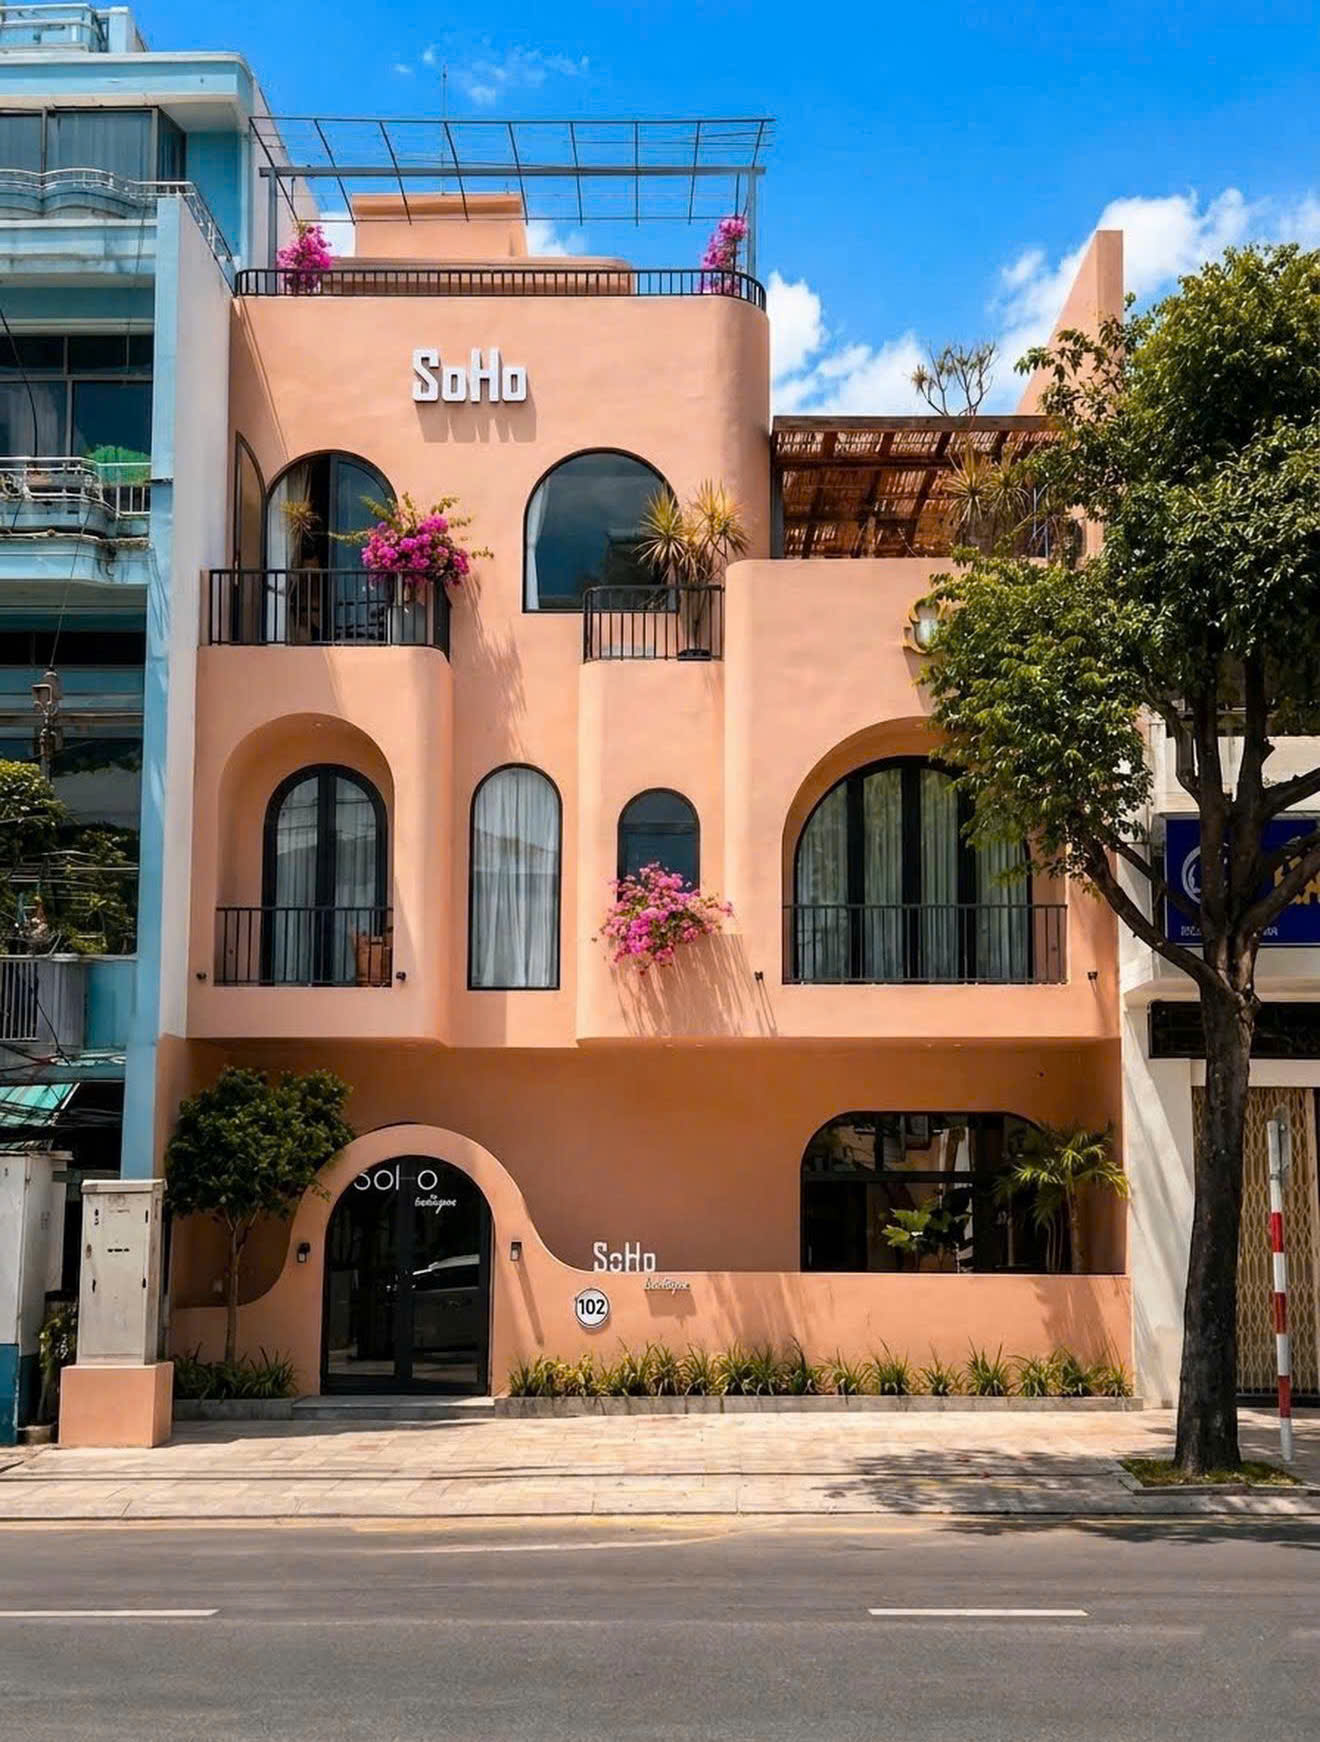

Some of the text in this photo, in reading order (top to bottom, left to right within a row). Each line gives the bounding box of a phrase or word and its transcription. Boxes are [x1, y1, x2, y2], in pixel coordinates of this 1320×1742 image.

[412, 347, 527, 402] SoHo
[593, 1241, 656, 1272] SoHo
[578, 1298, 606, 1315] 102
